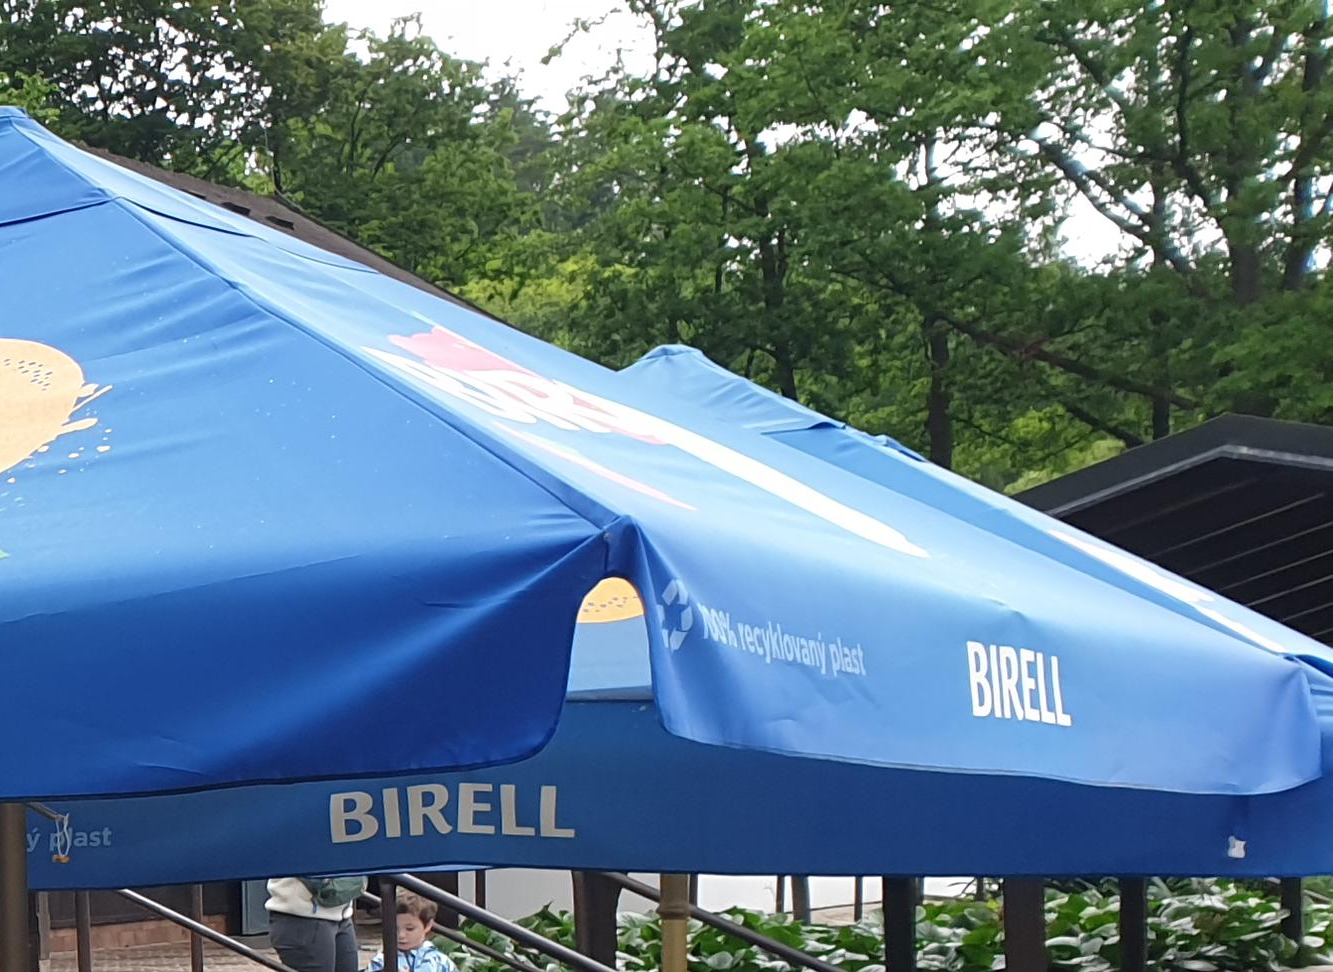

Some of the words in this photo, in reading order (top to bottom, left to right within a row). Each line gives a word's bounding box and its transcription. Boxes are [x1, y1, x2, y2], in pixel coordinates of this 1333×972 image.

[737, 620, 827, 675] recyklovaný
[829, 636, 866, 677] plast
[966, 640, 1072, 728] BIRELL
[331, 782, 576, 844] BIRELL
